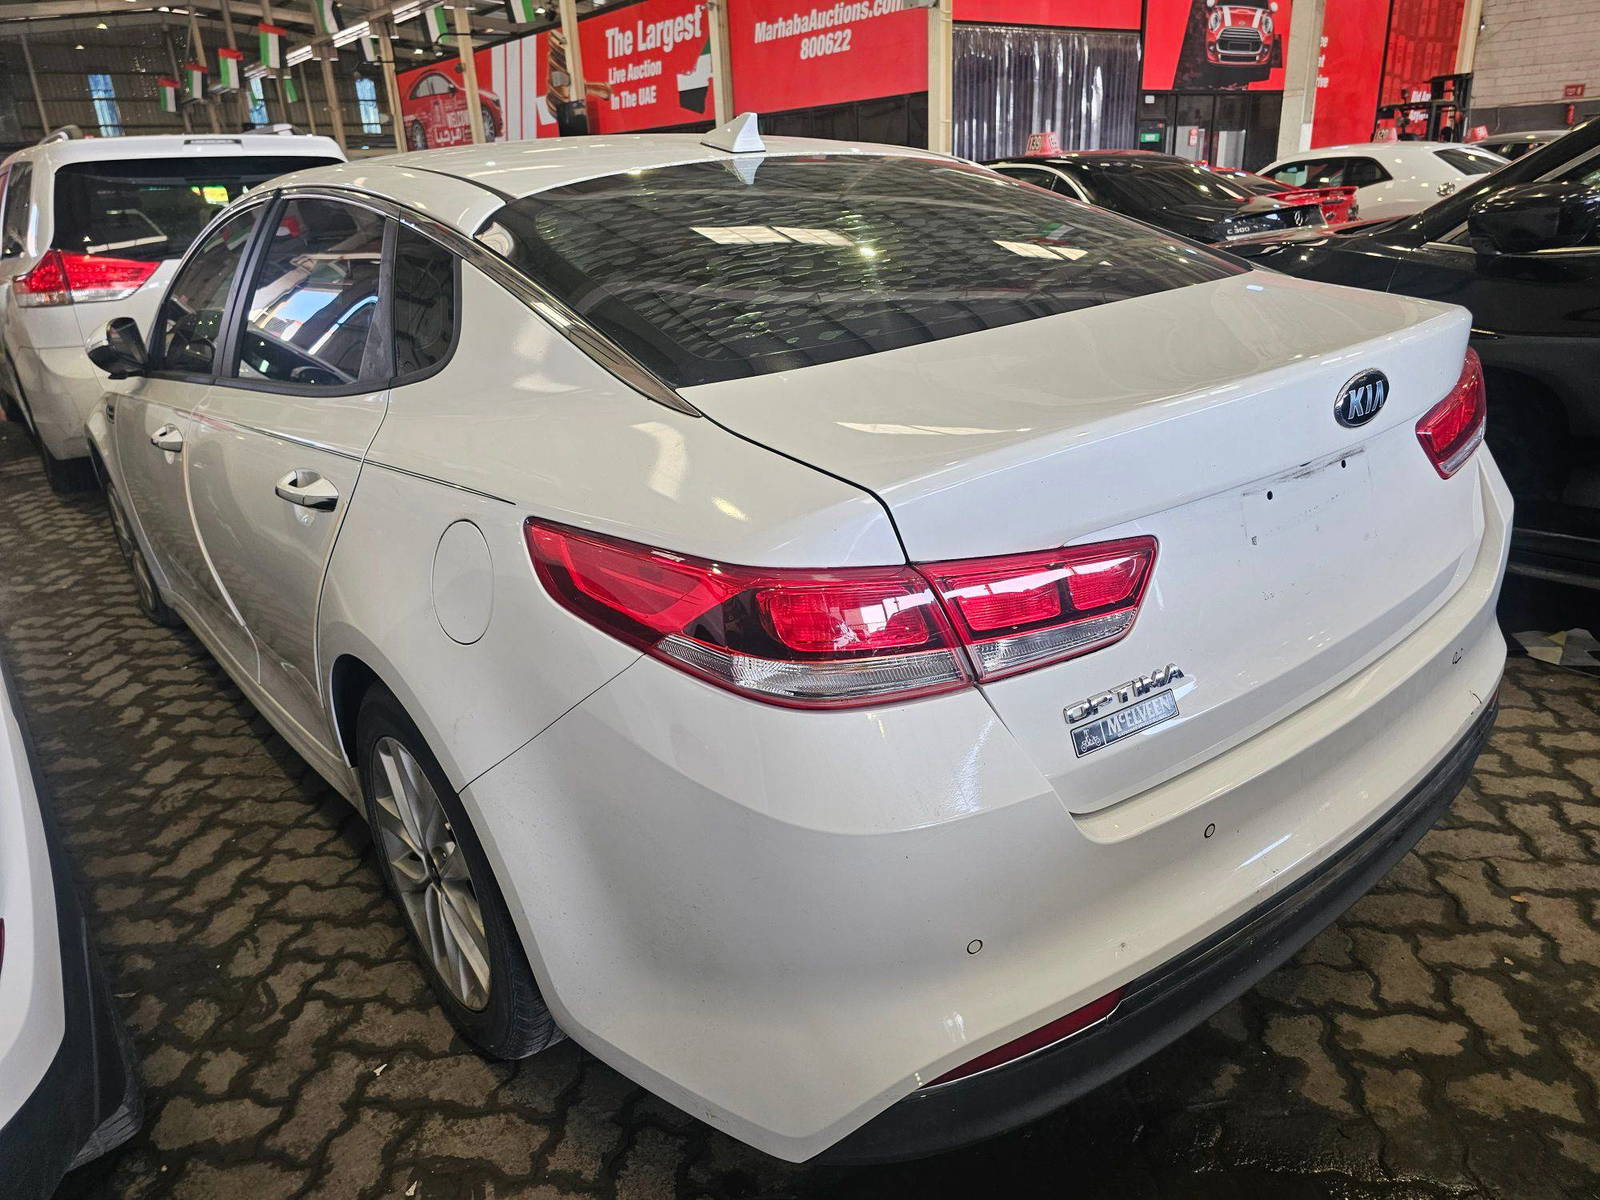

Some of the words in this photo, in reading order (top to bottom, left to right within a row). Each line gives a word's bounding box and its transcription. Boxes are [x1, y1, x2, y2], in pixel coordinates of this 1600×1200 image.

[605, 27, 634, 59] The
[637, 4, 703, 53] Largest
[800, 29, 853, 60] 800622
[608, 67, 626, 85] Live
[627, 60, 663, 82] Auction
[610, 93, 620, 110] In
[620, 91, 638, 109] The
[638, 85, 657, 106] UAE
[1347, 380, 1385, 420] KIA
[1063, 663, 1185, 724] OPTIMA
